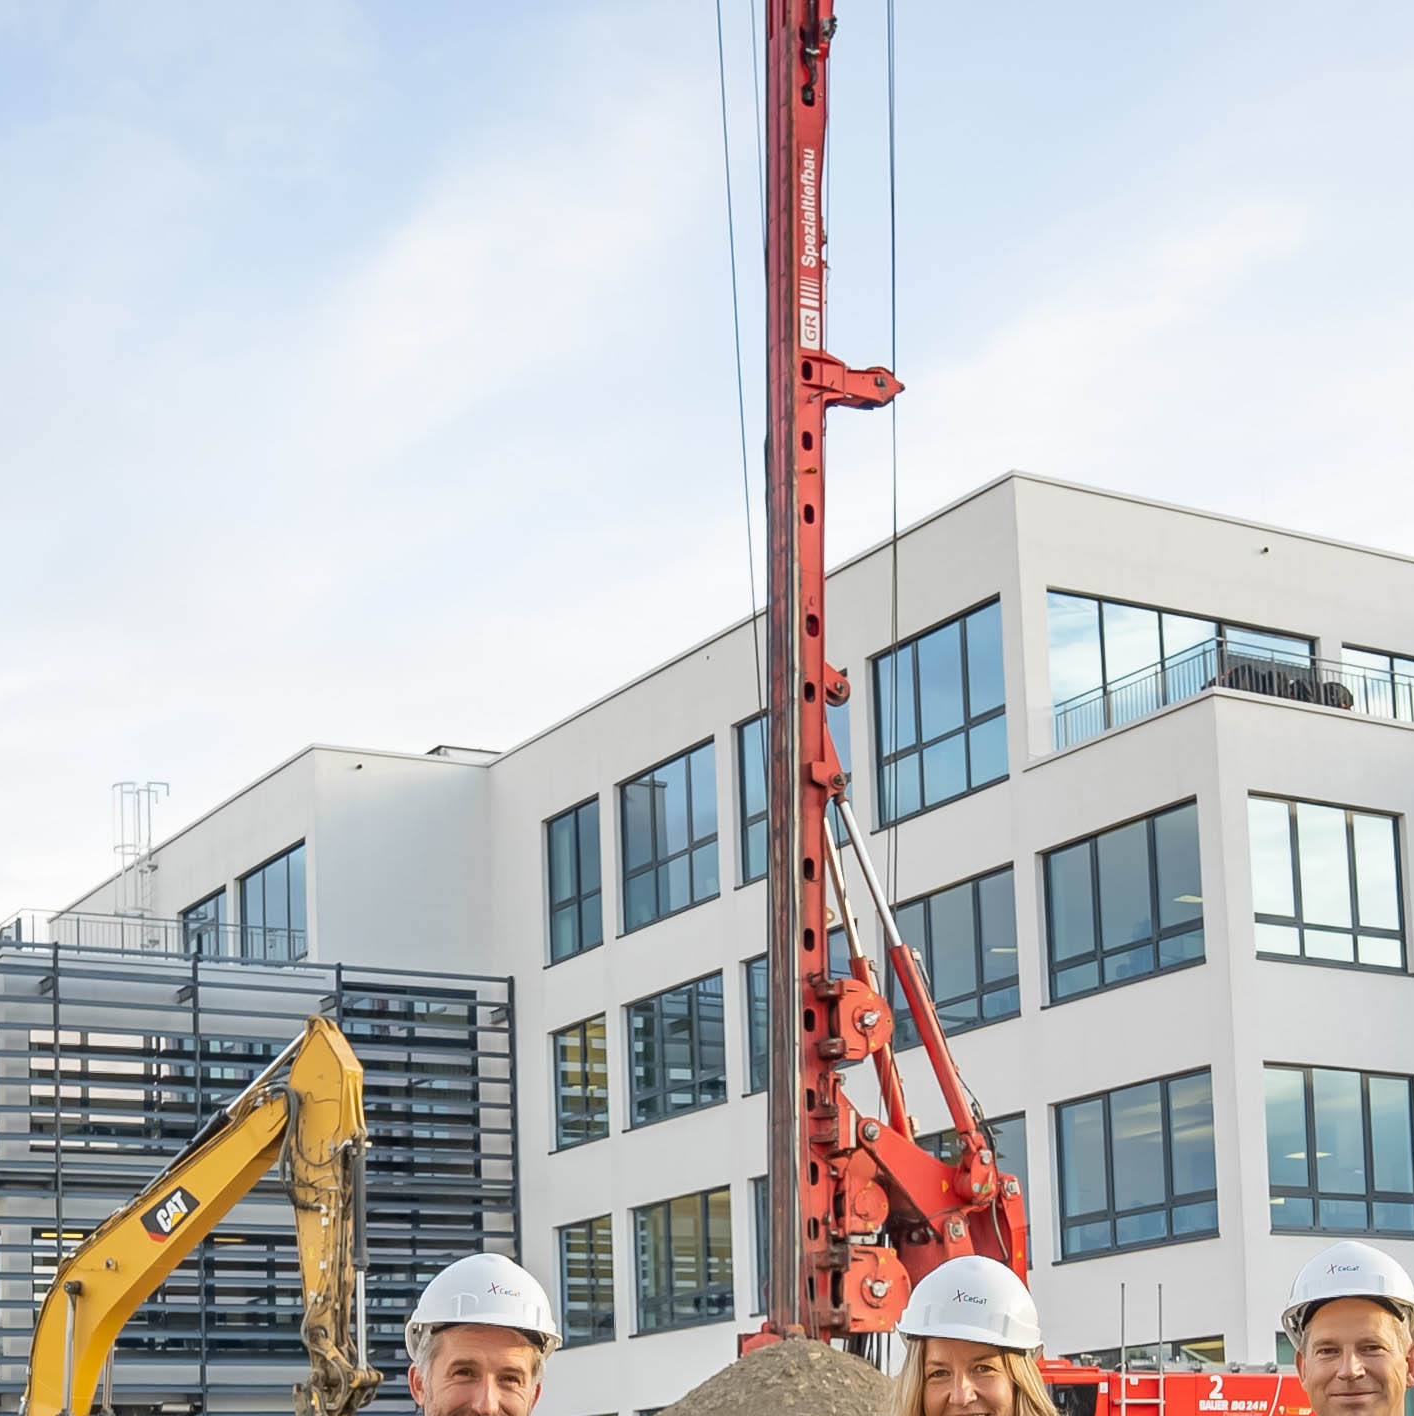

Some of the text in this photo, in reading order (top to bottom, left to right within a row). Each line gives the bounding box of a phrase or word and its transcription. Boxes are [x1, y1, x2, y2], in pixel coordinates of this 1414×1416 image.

[800, 148, 820, 342] GR Spezialtiefbau
[156, 1190, 189, 1233] CAT
[1209, 1375, 1224, 1400] 2
[1198, 1400, 1229, 1411] BAUER
